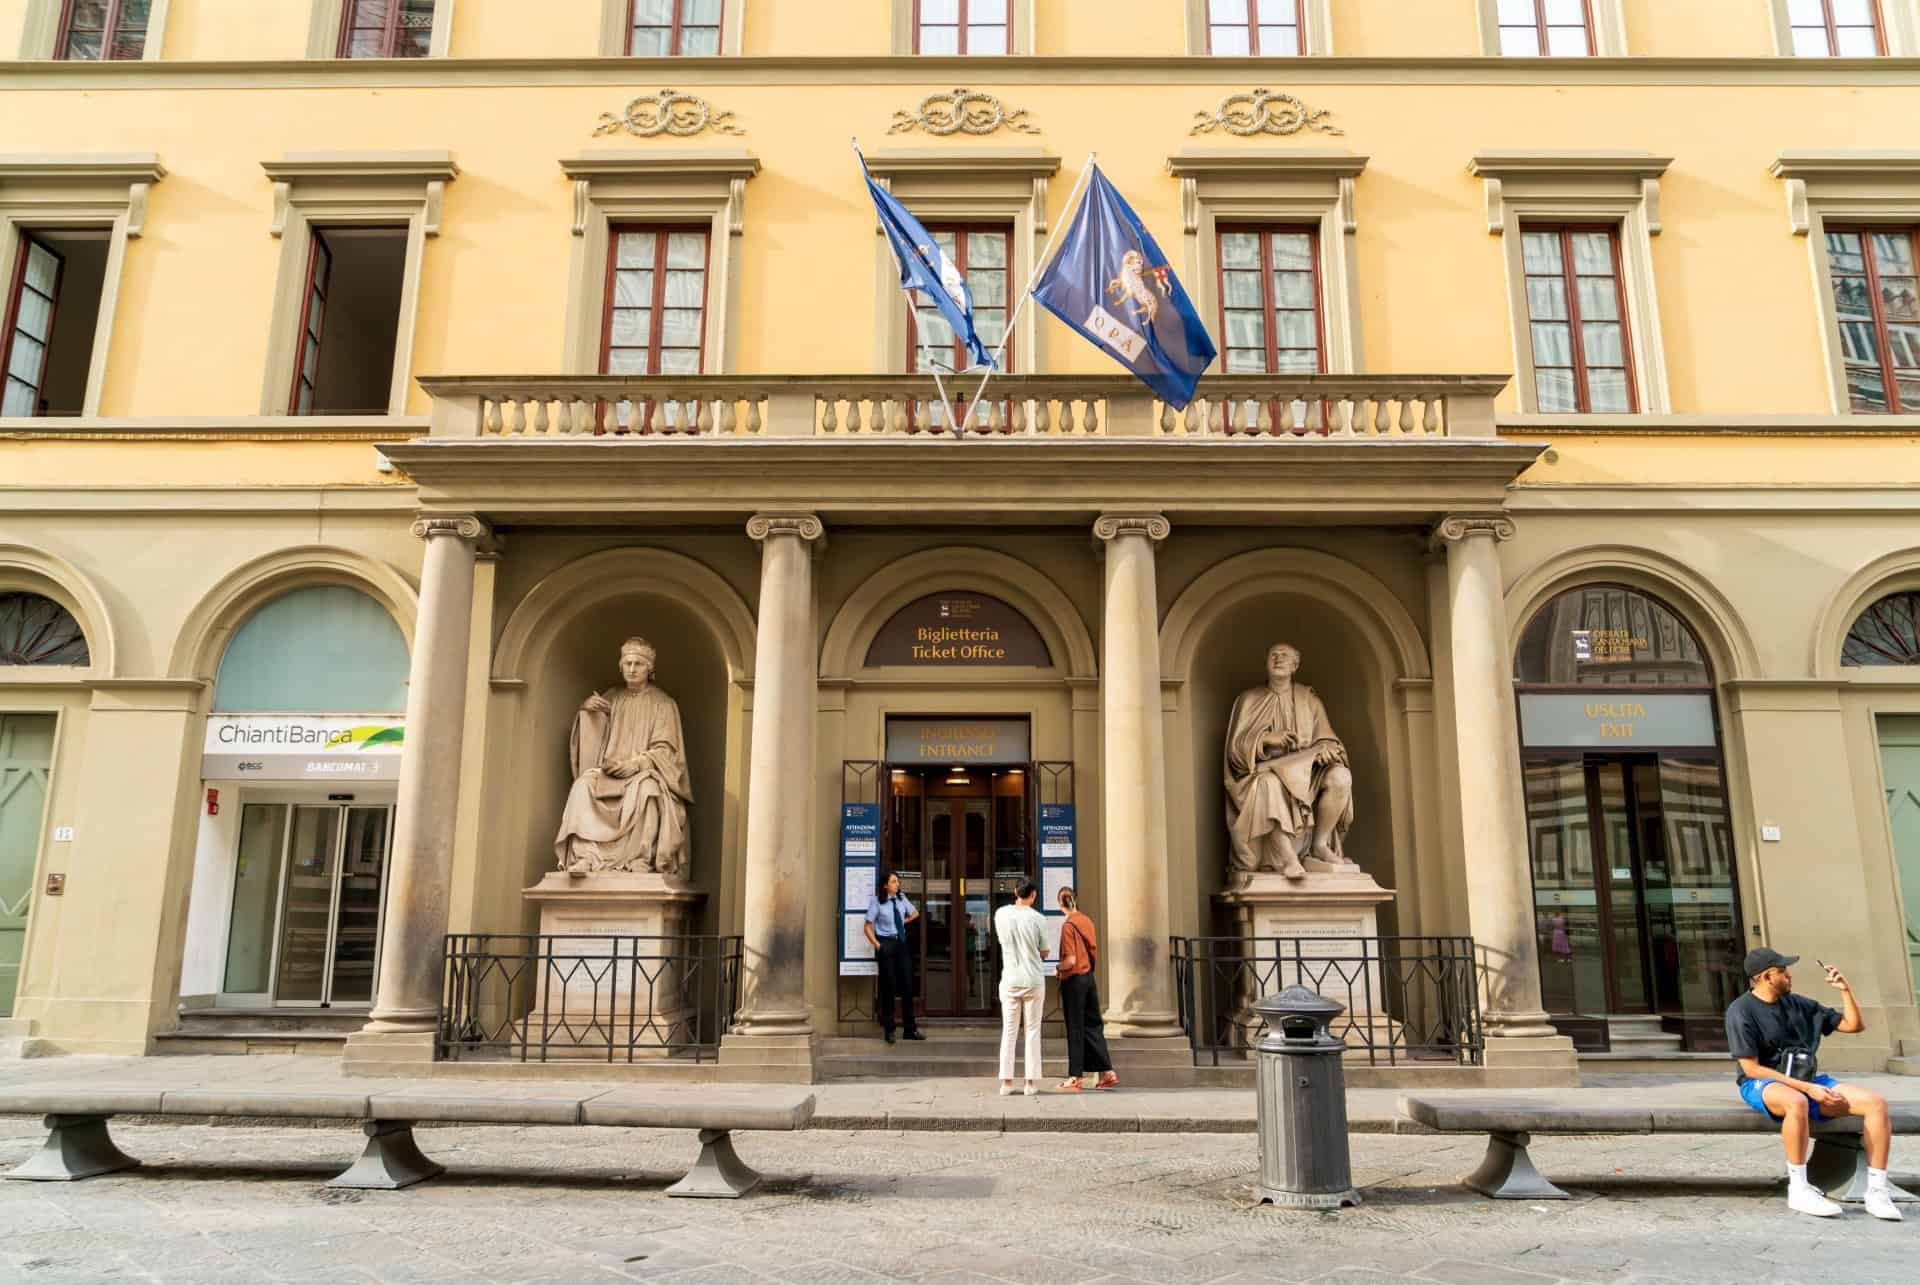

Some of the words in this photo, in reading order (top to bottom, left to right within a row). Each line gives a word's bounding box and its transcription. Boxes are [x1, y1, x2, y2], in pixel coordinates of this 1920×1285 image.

[917, 627, 1000, 643] Biglietteria
[911, 645, 957, 659] Ticket
[960, 645, 1006, 659] Office
[1584, 703, 1647, 719] USCITA
[218, 725, 353, 744] ChiantiBanca
[1599, 723, 1633, 737] EXIT
[305, 761, 368, 773] BANCOMAT
